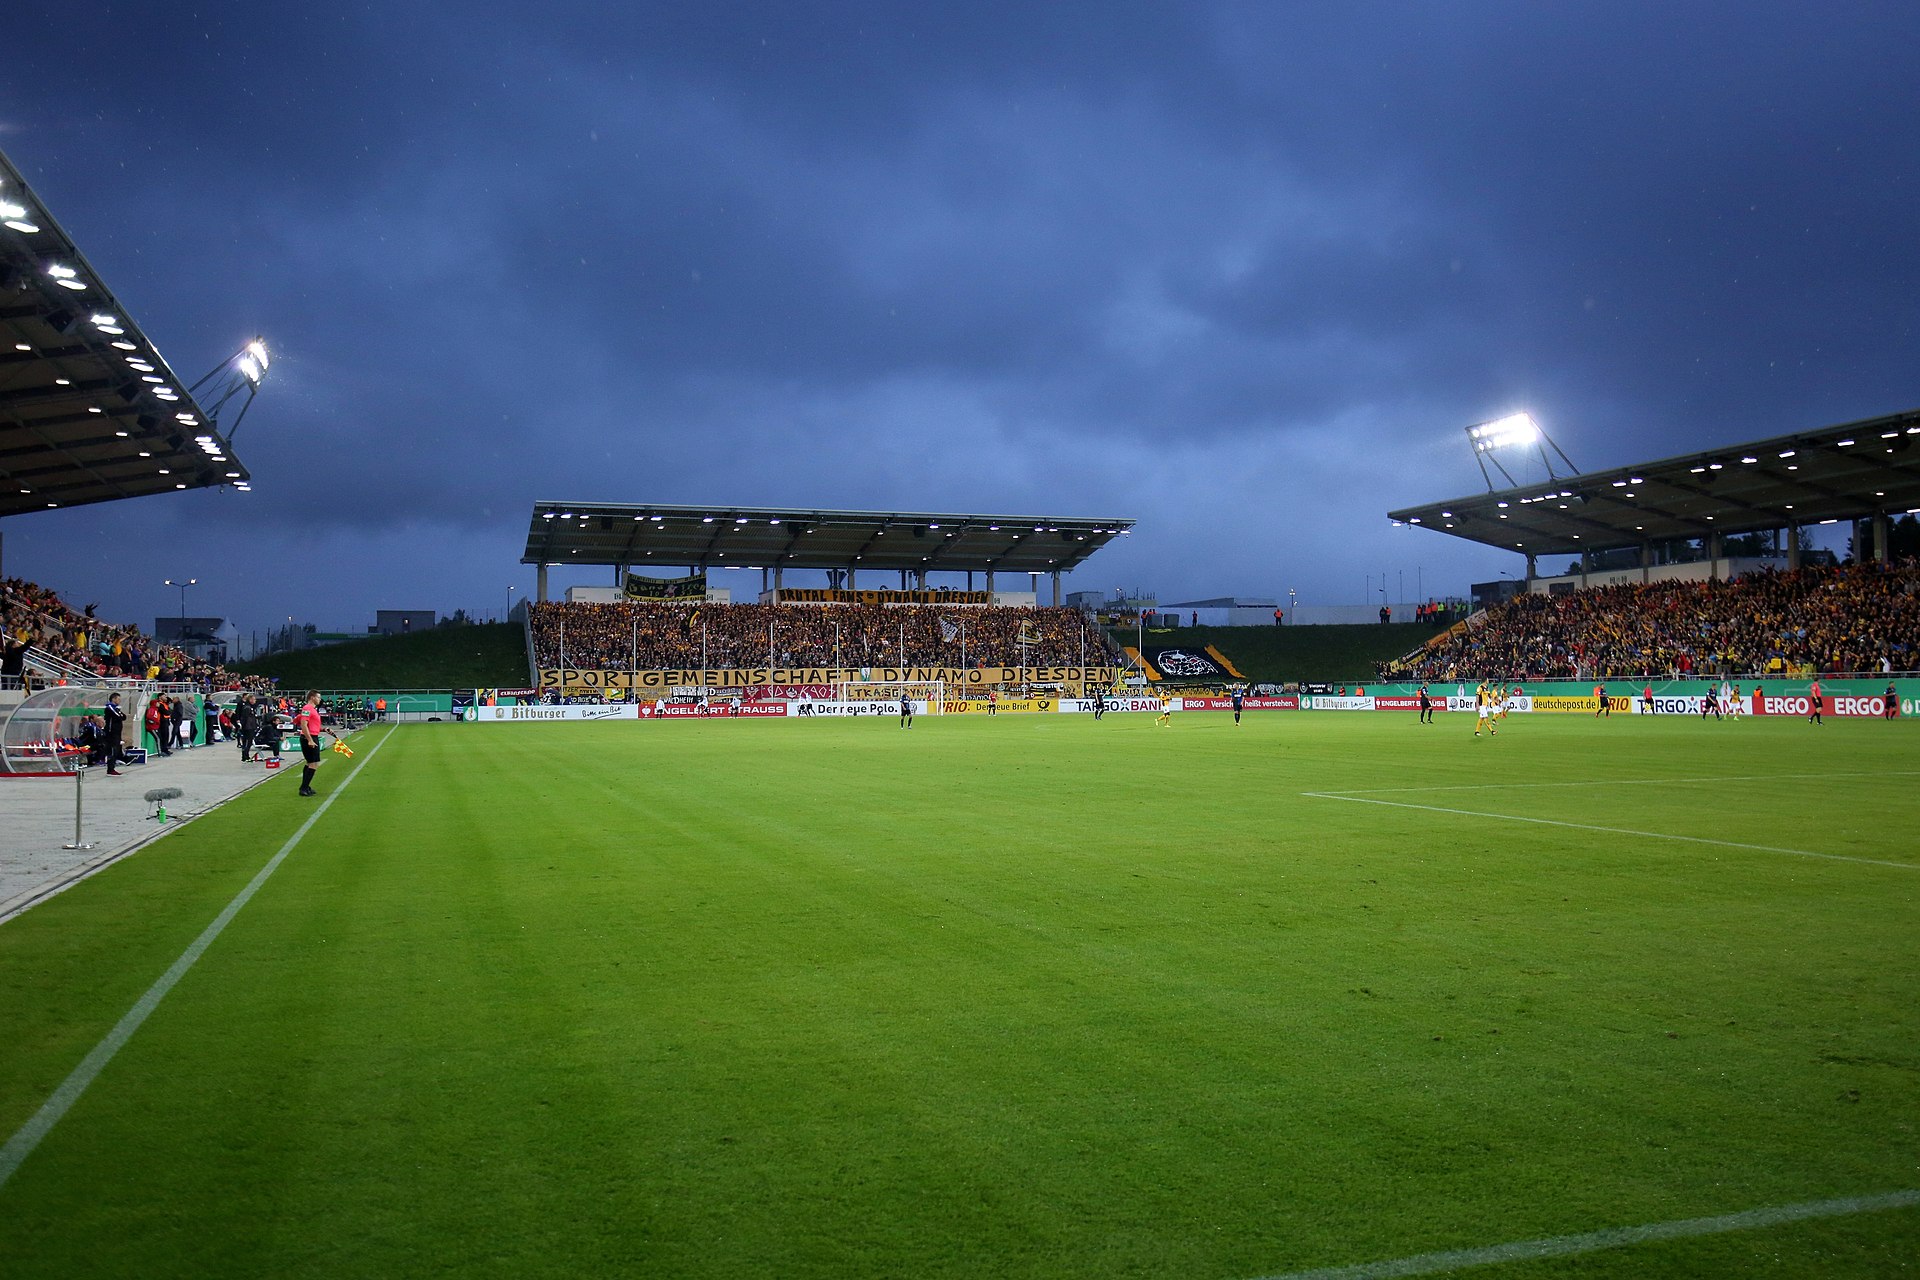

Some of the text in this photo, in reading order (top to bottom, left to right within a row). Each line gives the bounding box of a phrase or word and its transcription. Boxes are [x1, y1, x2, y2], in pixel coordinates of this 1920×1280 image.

[779, 590, 990, 604] BRUTAL FANS DYNAMO DRESDEN
[543, 668, 1112, 687] SPORTGEMEINSCHAFT DYNAMO DRESDEN
[818, 704, 838, 714] Der
[870, 703, 898, 713] Polo.
[1012, 702, 1030, 711] Brief
[1185, 700, 1205, 708] ERGO
[1244, 699, 1262, 708] heißt
[1262, 700, 1294, 708] verstehen.
[1460, 699, 1473, 709] Der
[1533, 698, 1596, 711] deutschepost.de
[1608, 697, 1629, 711] RIO
[1637, 699, 1686, 713] TRGO
[1764, 697, 1809, 714] ERGO
[1834, 697, 1885, 715] ERGO
[511, 707, 566, 719] Bitburger
